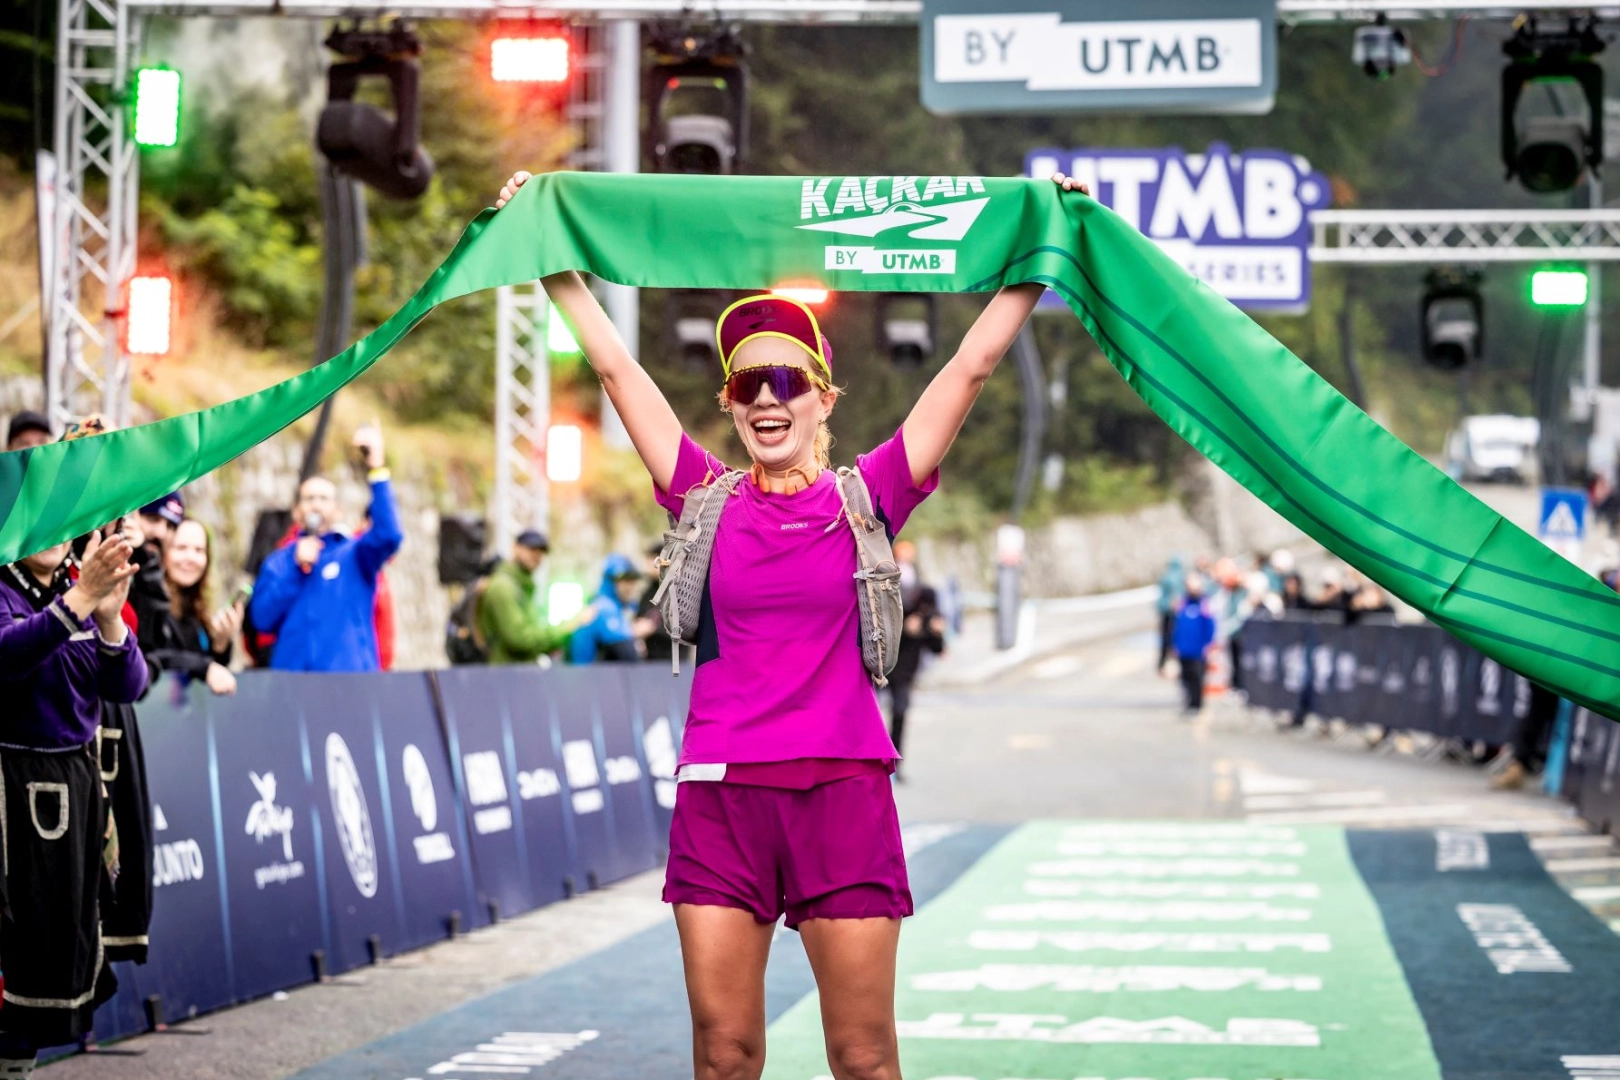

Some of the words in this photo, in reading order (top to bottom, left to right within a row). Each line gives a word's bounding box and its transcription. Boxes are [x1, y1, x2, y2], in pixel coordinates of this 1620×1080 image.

[963, 30, 1016, 66] BY
[1080, 37, 1221, 74] UTMB
[836, 250, 858, 265] BY
[882, 253, 941, 270] UTMB
[780, 522, 809, 531] BROOKS
